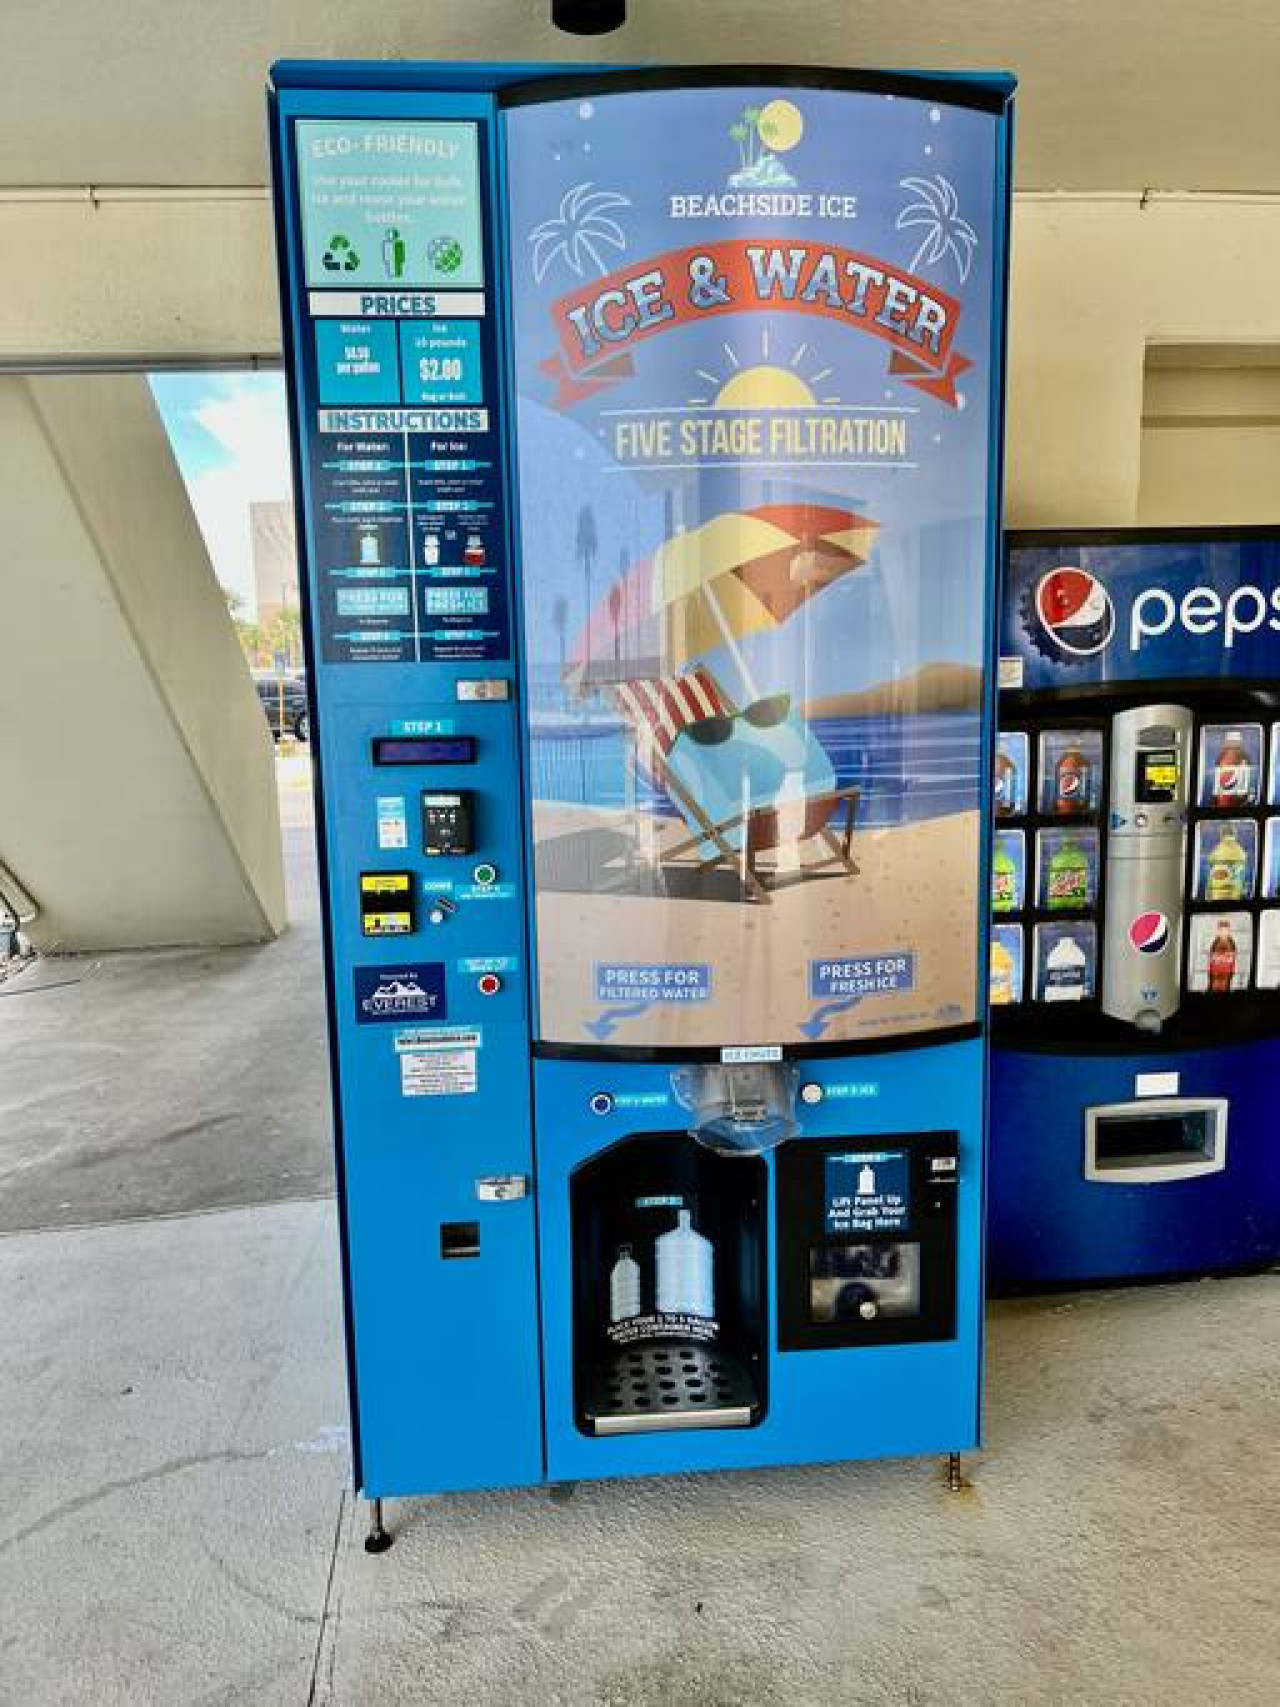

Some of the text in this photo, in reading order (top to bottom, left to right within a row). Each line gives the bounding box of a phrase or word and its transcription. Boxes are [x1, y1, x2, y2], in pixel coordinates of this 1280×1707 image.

[669, 194, 857, 218] BEACHSIDE ICE
[361, 296, 436, 313] PRICES
[566, 243, 950, 358] ICE & WATER
[419, 358, 463, 382] $2.00
[326, 411, 482, 431] INSTRUCTIONS
[616, 419, 906, 459] FIVE STAGE FILTRATION
[606, 969, 701, 985] PRESS FOR
[819, 958, 907, 981] PRESS FOR
[600, 986, 708, 1000] FILTERED WATER
[829, 975, 897, 994] FRESH ICE
[829, 1207, 851, 1218] And
